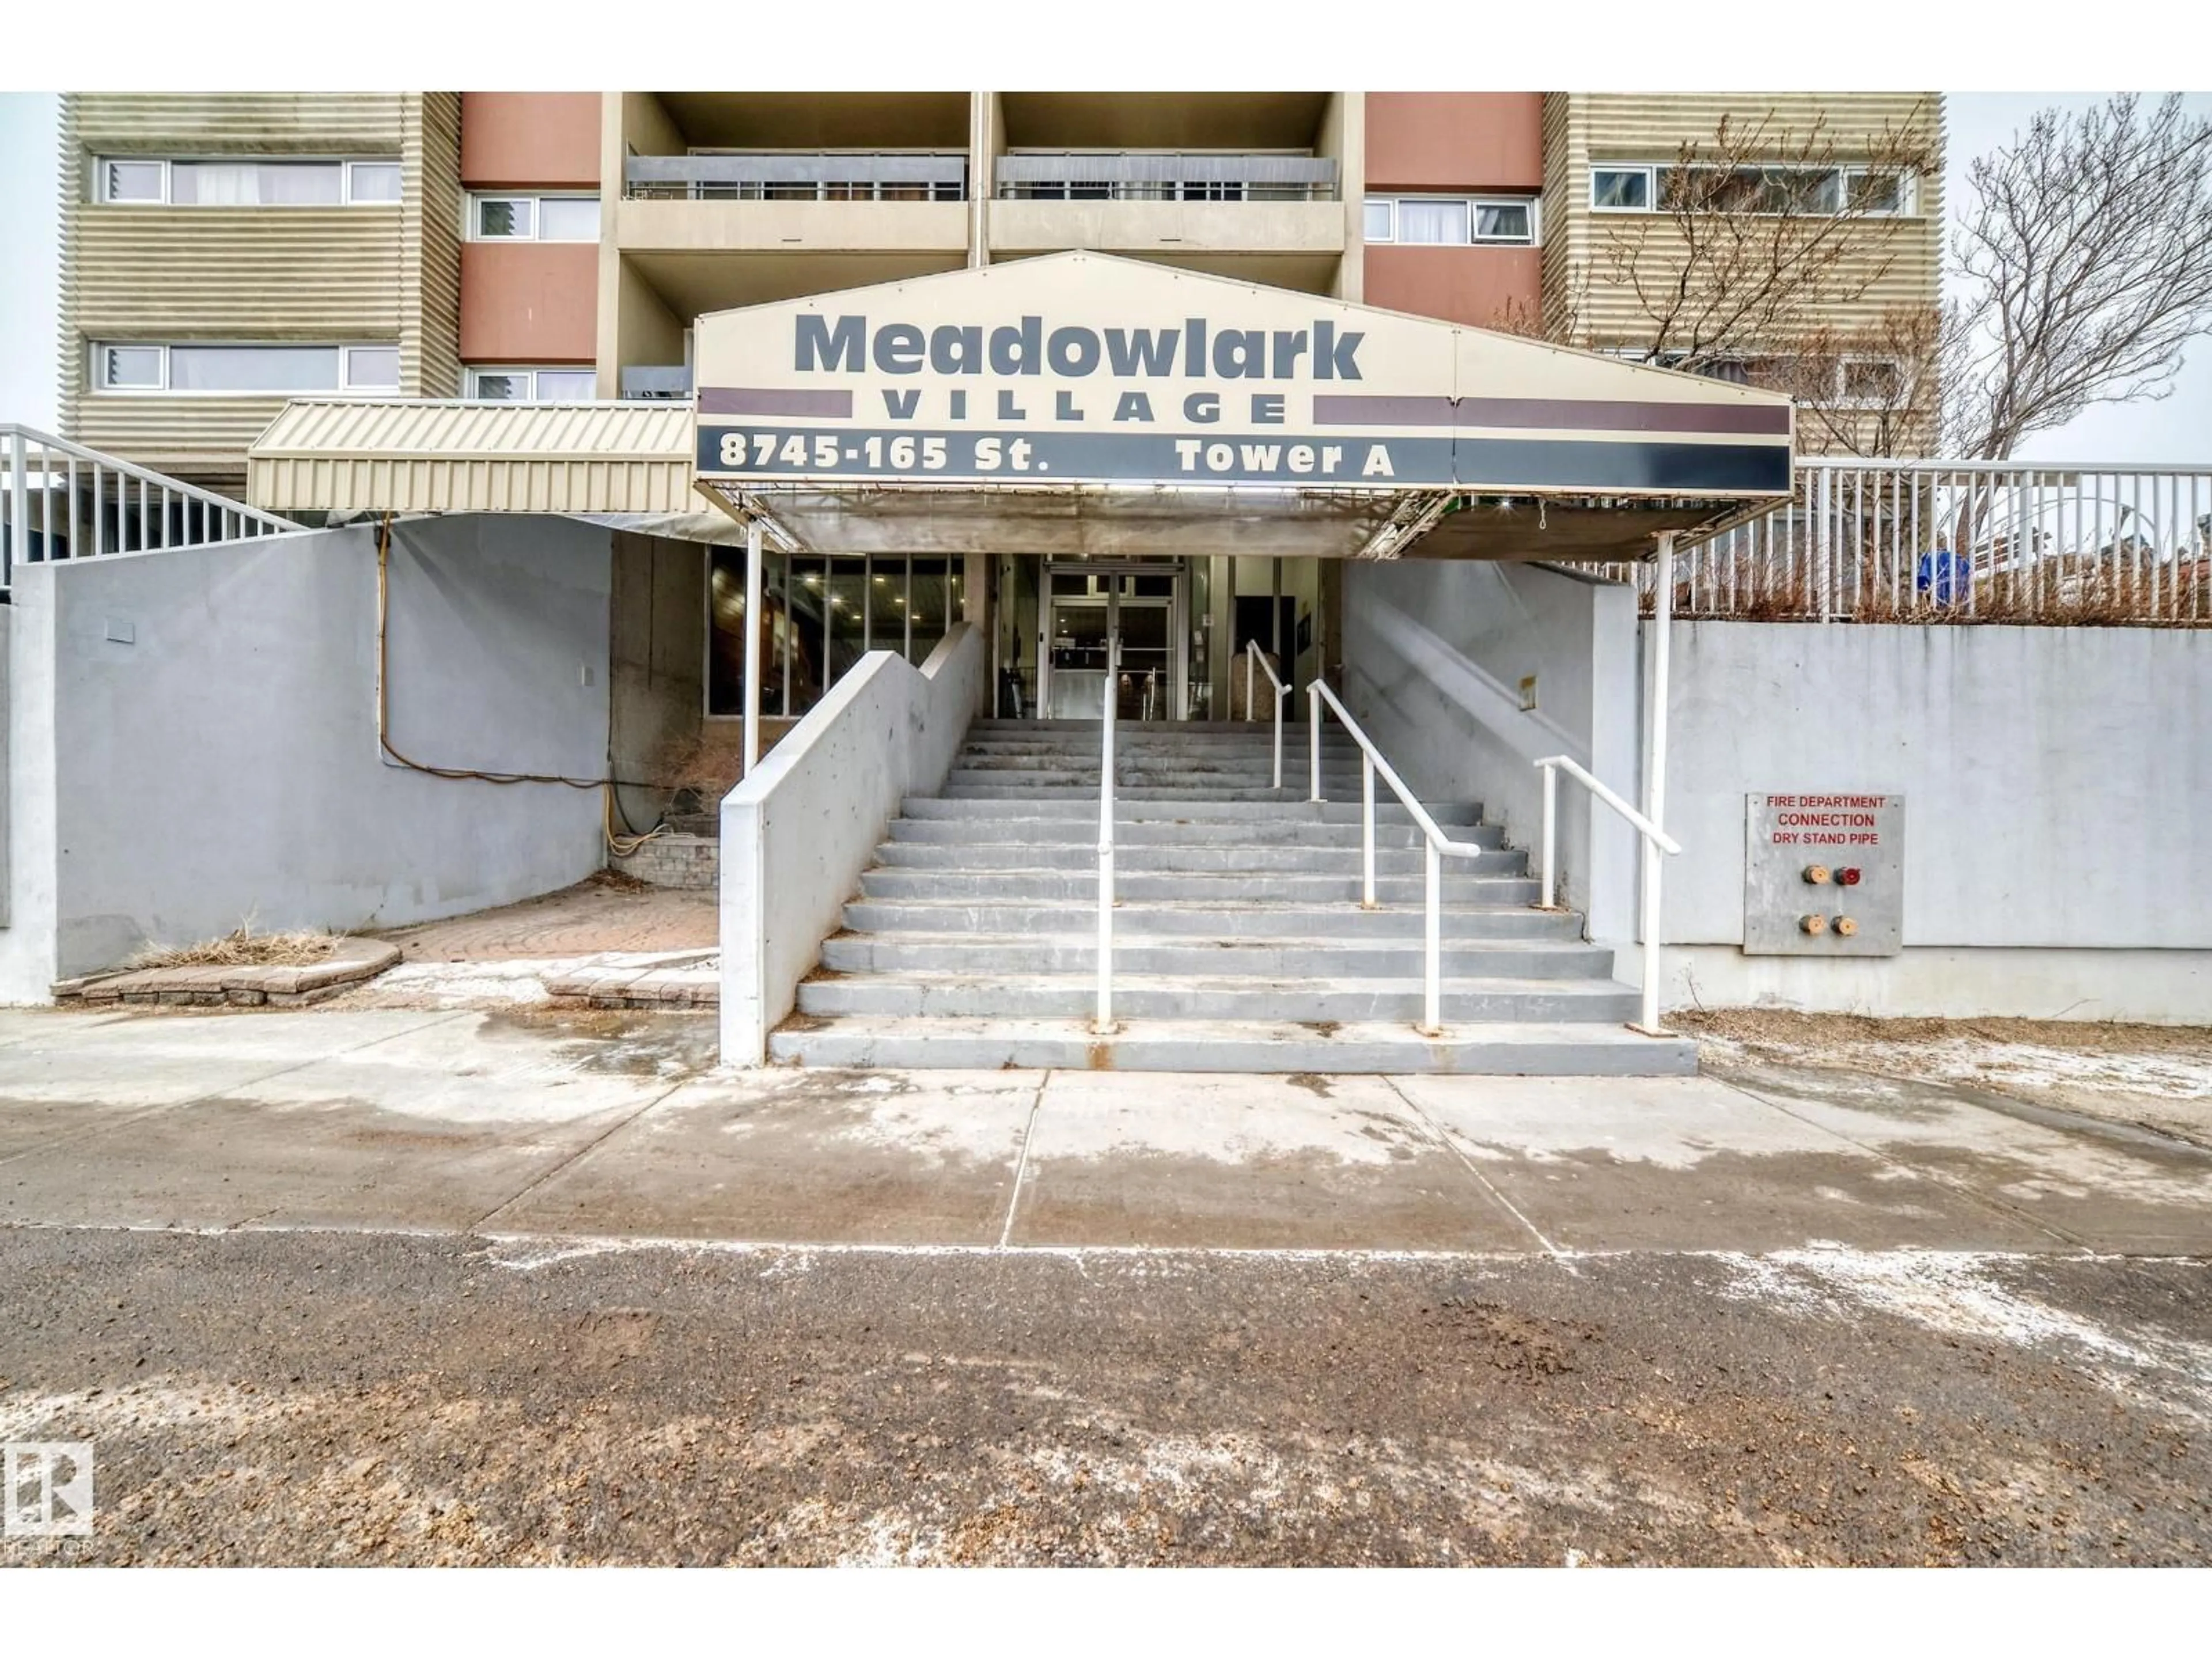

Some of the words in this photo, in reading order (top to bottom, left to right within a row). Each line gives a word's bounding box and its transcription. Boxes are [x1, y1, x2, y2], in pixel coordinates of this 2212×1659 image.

[795, 314, 1366, 381] Meadowlark
[882, 389, 1285, 424] VILLAGE
[719, 433, 948, 469] 8745-165
[975, 437, 1048, 471] St.
[1176, 440, 1341, 474] Tower
[1361, 445, 1395, 475] A
[1767, 796, 1796, 806] FIRE
[1800, 797, 1885, 808] DEPARTMENT
[1778, 813, 1874, 826] CONNECTION
[1772, 833, 1799, 844] DRY
[1803, 833, 1845, 844] STAND
[1850, 834, 1878, 844] PIPE
